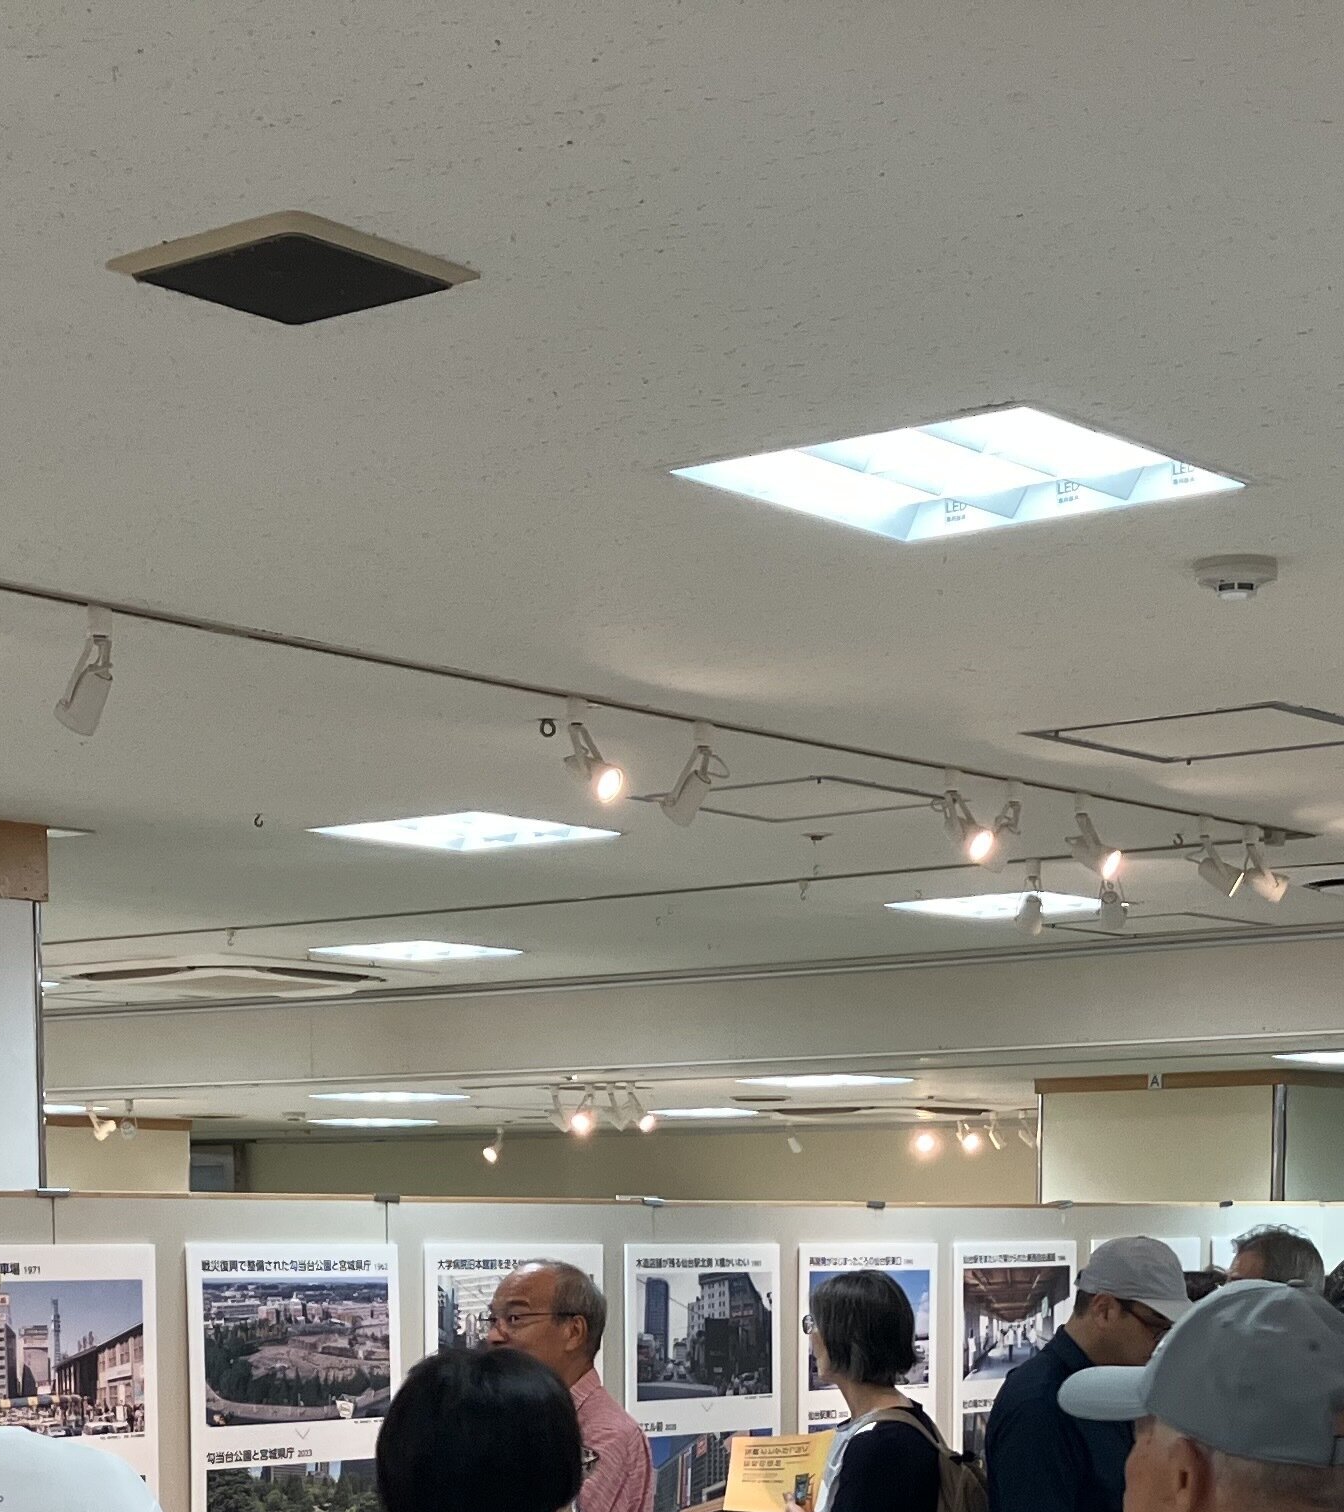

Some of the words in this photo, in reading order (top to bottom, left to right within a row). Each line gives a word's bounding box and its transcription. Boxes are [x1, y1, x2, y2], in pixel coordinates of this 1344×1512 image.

[1150, 1075, 1160, 1087] A
[23, 1266, 41, 1275] 1971
[201, 1259, 371, 1272] 戦災復興で整備された勾当台公園と宮城県庁
[207, 1447, 295, 1464] 勾当台公園と宮城県庁
